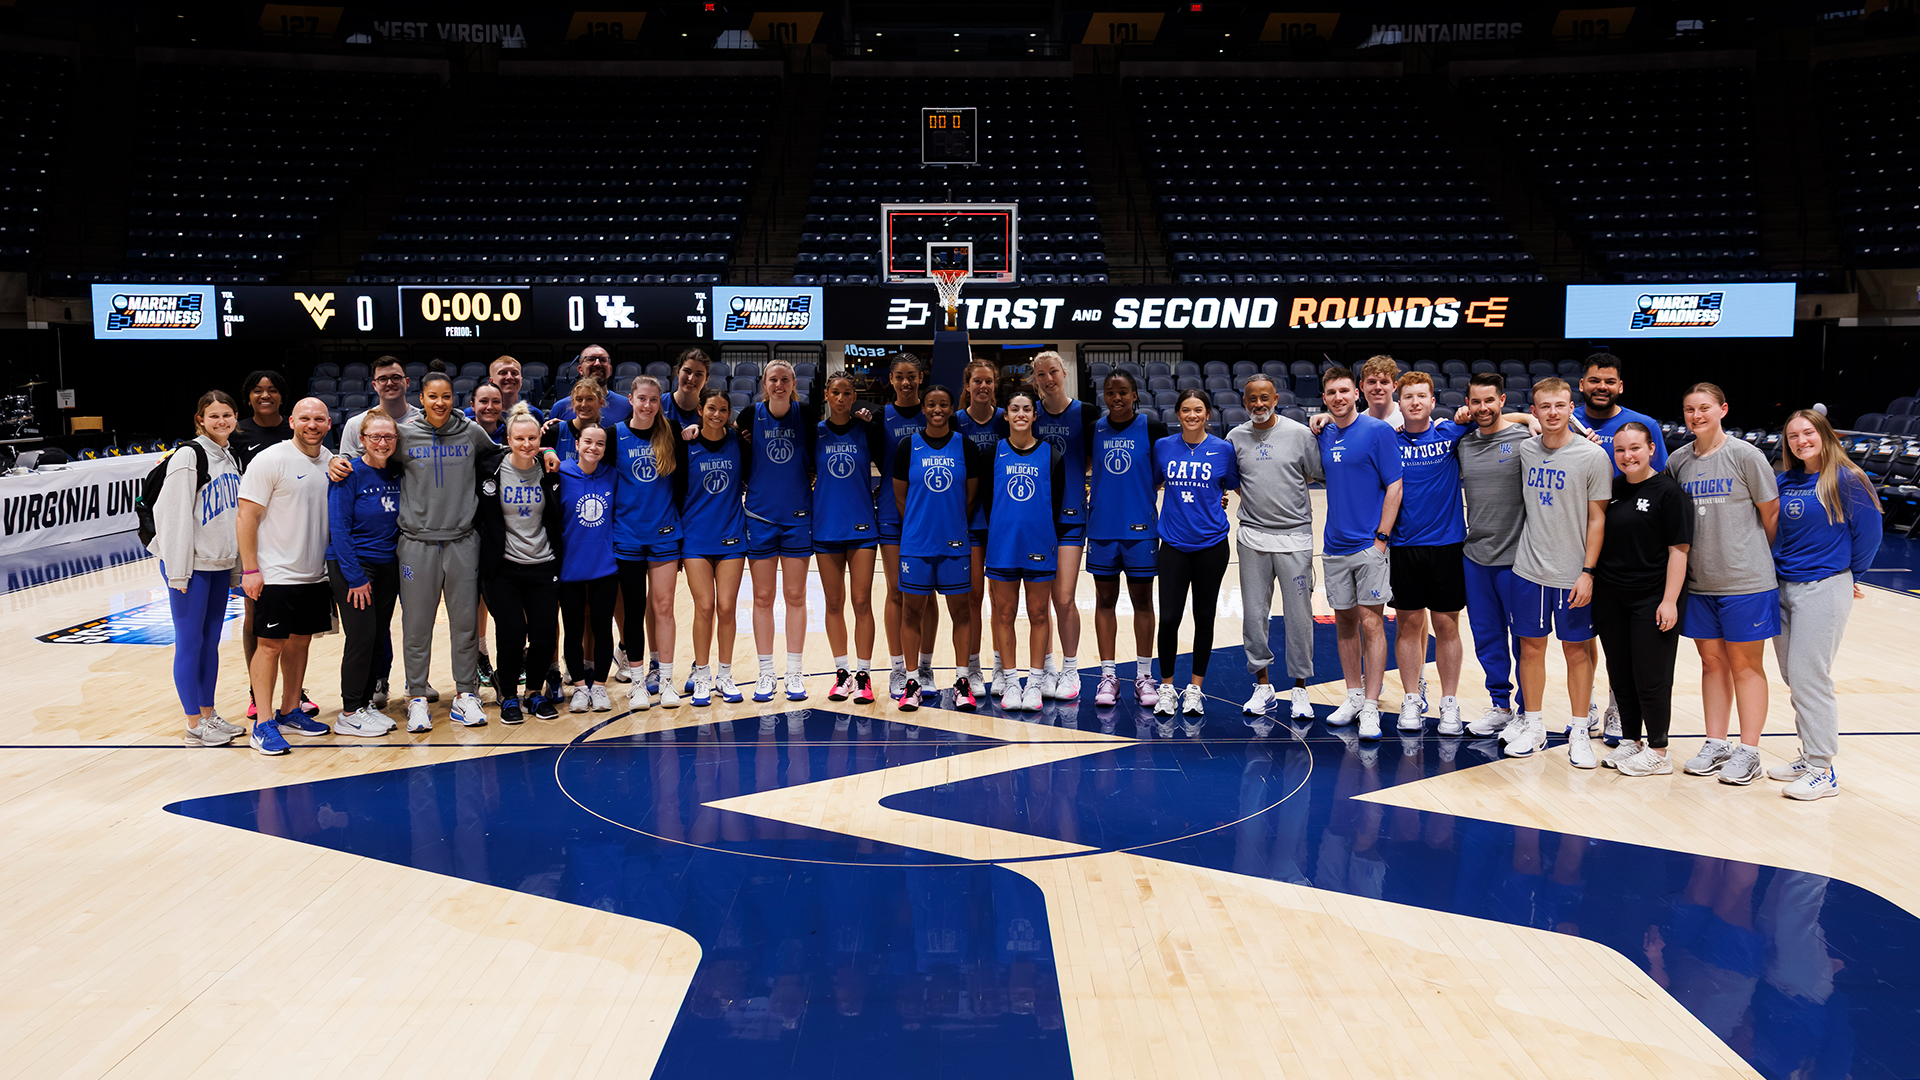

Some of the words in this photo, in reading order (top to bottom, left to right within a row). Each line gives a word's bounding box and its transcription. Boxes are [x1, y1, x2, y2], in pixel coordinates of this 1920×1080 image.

[281, 15, 319, 38] 127
[374, 21, 428, 41] WEST
[437, 23, 526, 43] VIRGINIA
[768, 22, 798, 43] 101
[1108, 23, 1138, 43] 101
[1371, 22, 1523, 43] MOUNTAINEERS
[127, 297, 178, 311] MARCH
[224, 300, 232, 314] 4
[421, 292, 522, 321] 0:00.0
[696, 300, 704, 314] 4
[743, 298, 789, 312] MARCH
[1651, 296, 1699, 310] MARCH
[134, 311, 201, 325] MADNESS
[357, 295, 373, 331] 0
[568, 295, 585, 331] 0
[749, 312, 809, 326] MADNESS
[1071, 309, 1102, 322] AND
[1112, 298, 1278, 329] SECOND
[1289, 297, 1461, 328] ROUNDS
[1656, 309, 1720, 323] MADNESS
[224, 323, 232, 337] 0
[445, 326, 472, 337] PERIOD:
[476, 325, 480, 337] 1
[696, 323, 704, 337] 0
[764, 428, 796, 439] WILDCATS
[969, 433, 1000, 443] WILDCATS
[1038, 426, 1070, 436] WILDCATS
[825, 445, 858, 454] WILDCATS
[1103, 439, 1135, 449] WILDCATS
[408, 445, 468, 459] KENTUCKY
[628, 448, 655, 458] WILDCA
[774, 447, 787, 460] 20
[1333, 451, 1342, 462] UK
[700, 460, 733, 472] WILDCATS
[838, 462, 845, 475] 4
[921, 458, 955, 468] WILDCATS
[1114, 458, 1121, 471] 0
[641, 466, 653, 478] 12
[1006, 465, 1039, 477] WILDCATS
[1167, 460, 1212, 481] CATS
[712, 480, 721, 491] 11
[935, 475, 942, 488] 5
[1527, 467, 1566, 490] CATS
[1017, 484, 1024, 497] 8
[1682, 478, 1734, 494] ENTUCKY
[503, 485, 542, 504] CATS
[1181, 491, 1195, 503] UK
[1539, 491, 1553, 506] UK
[3, 484, 100, 536] VIRGINIA
[1636, 498, 1650, 512] UK
